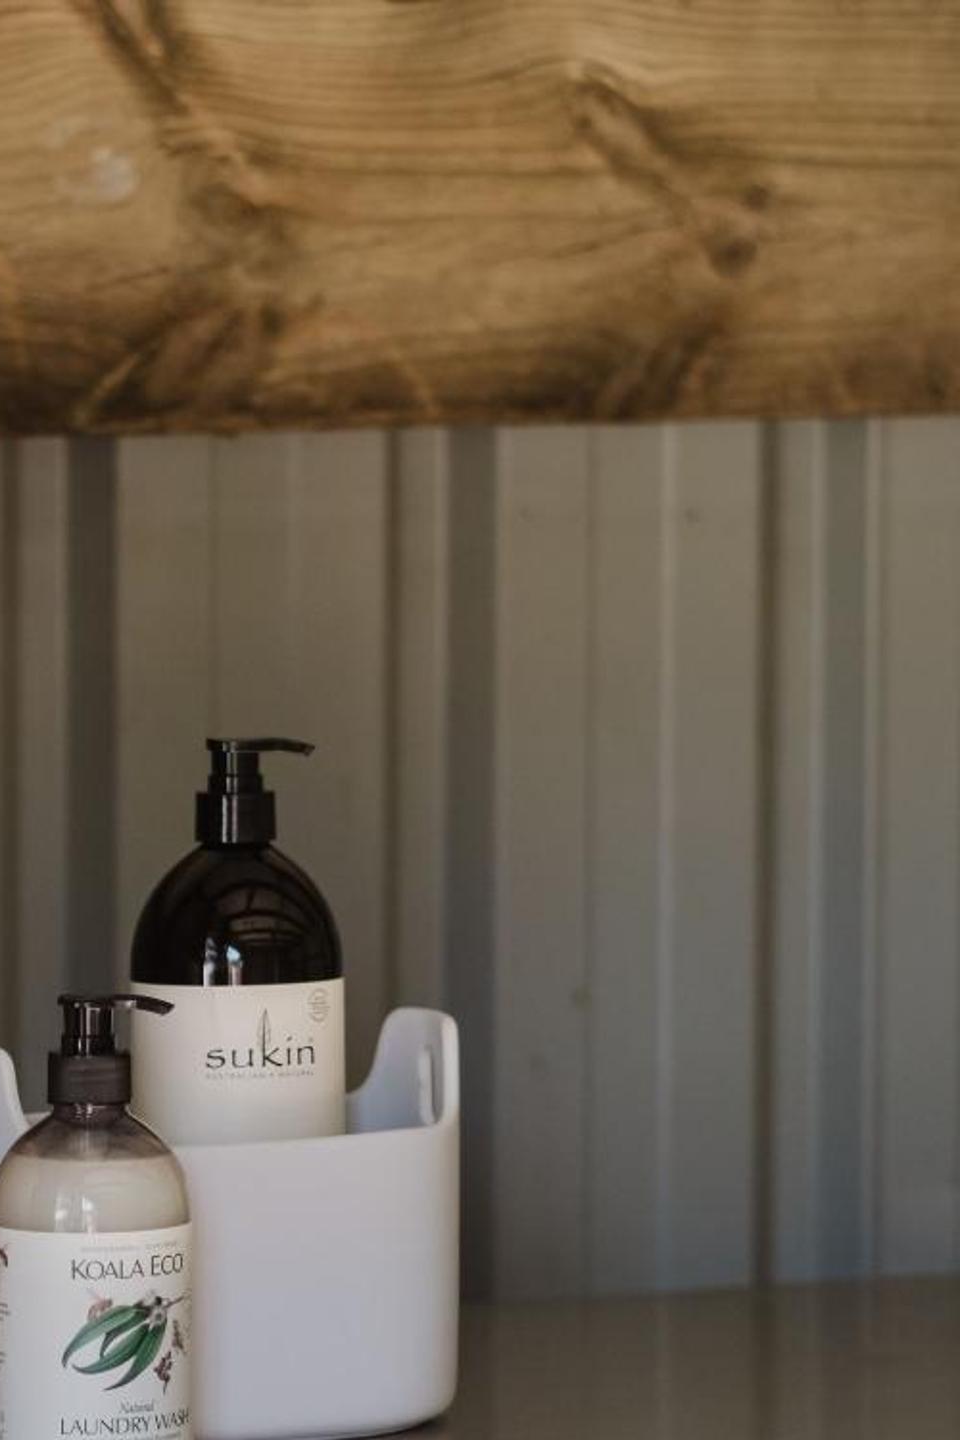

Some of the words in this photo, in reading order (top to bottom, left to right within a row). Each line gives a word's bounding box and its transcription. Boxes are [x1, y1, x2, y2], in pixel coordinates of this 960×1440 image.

[205, 1008, 316, 1069] sukin
[71, 1258, 145, 1281] KOALA
[150, 1252, 184, 1276] ECO
[60, 1416, 151, 1435] LAUNDRY
[154, 1407, 190, 1429] WASH
